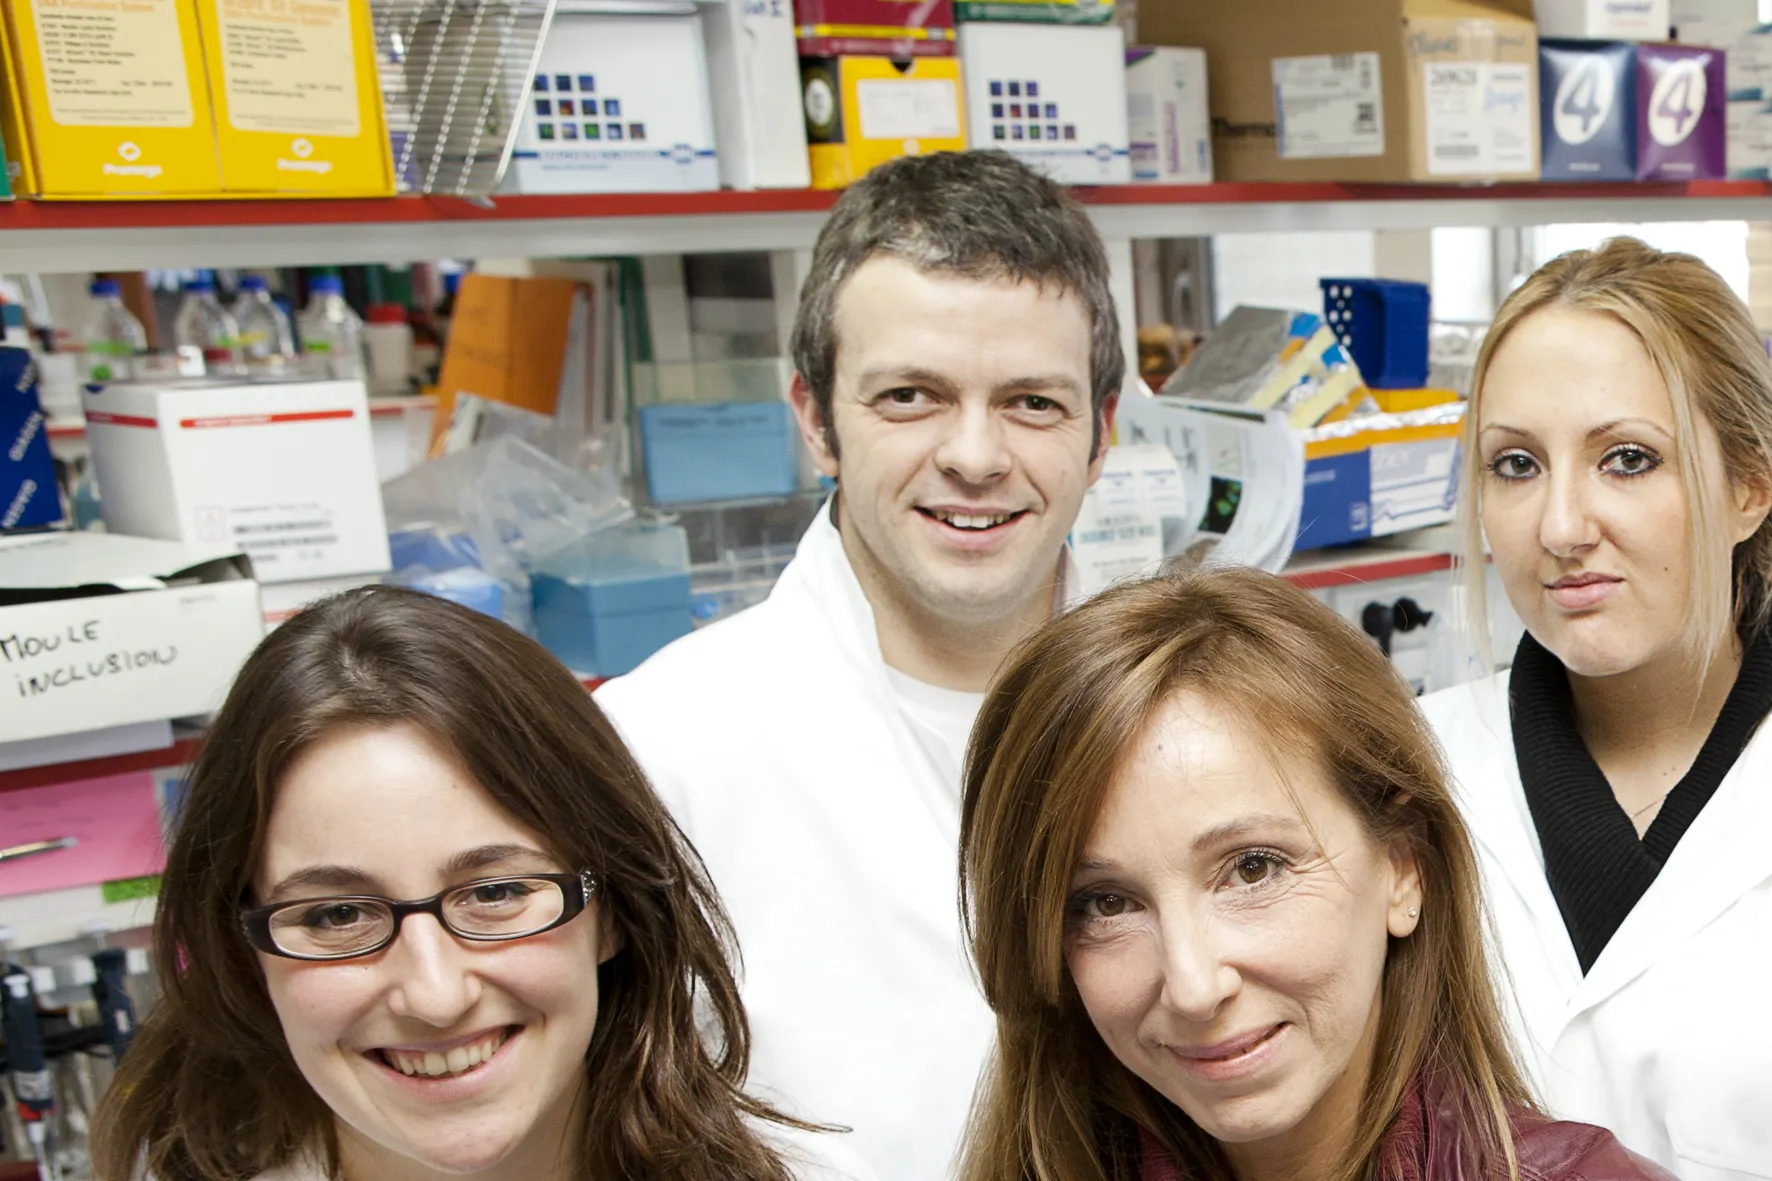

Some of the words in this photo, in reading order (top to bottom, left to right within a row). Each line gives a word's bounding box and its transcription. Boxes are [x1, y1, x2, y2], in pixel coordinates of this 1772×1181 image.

[1561, 61, 1600, 134] 4
[1657, 67, 1694, 134] 4
[0, 620, 100, 662] MOULE
